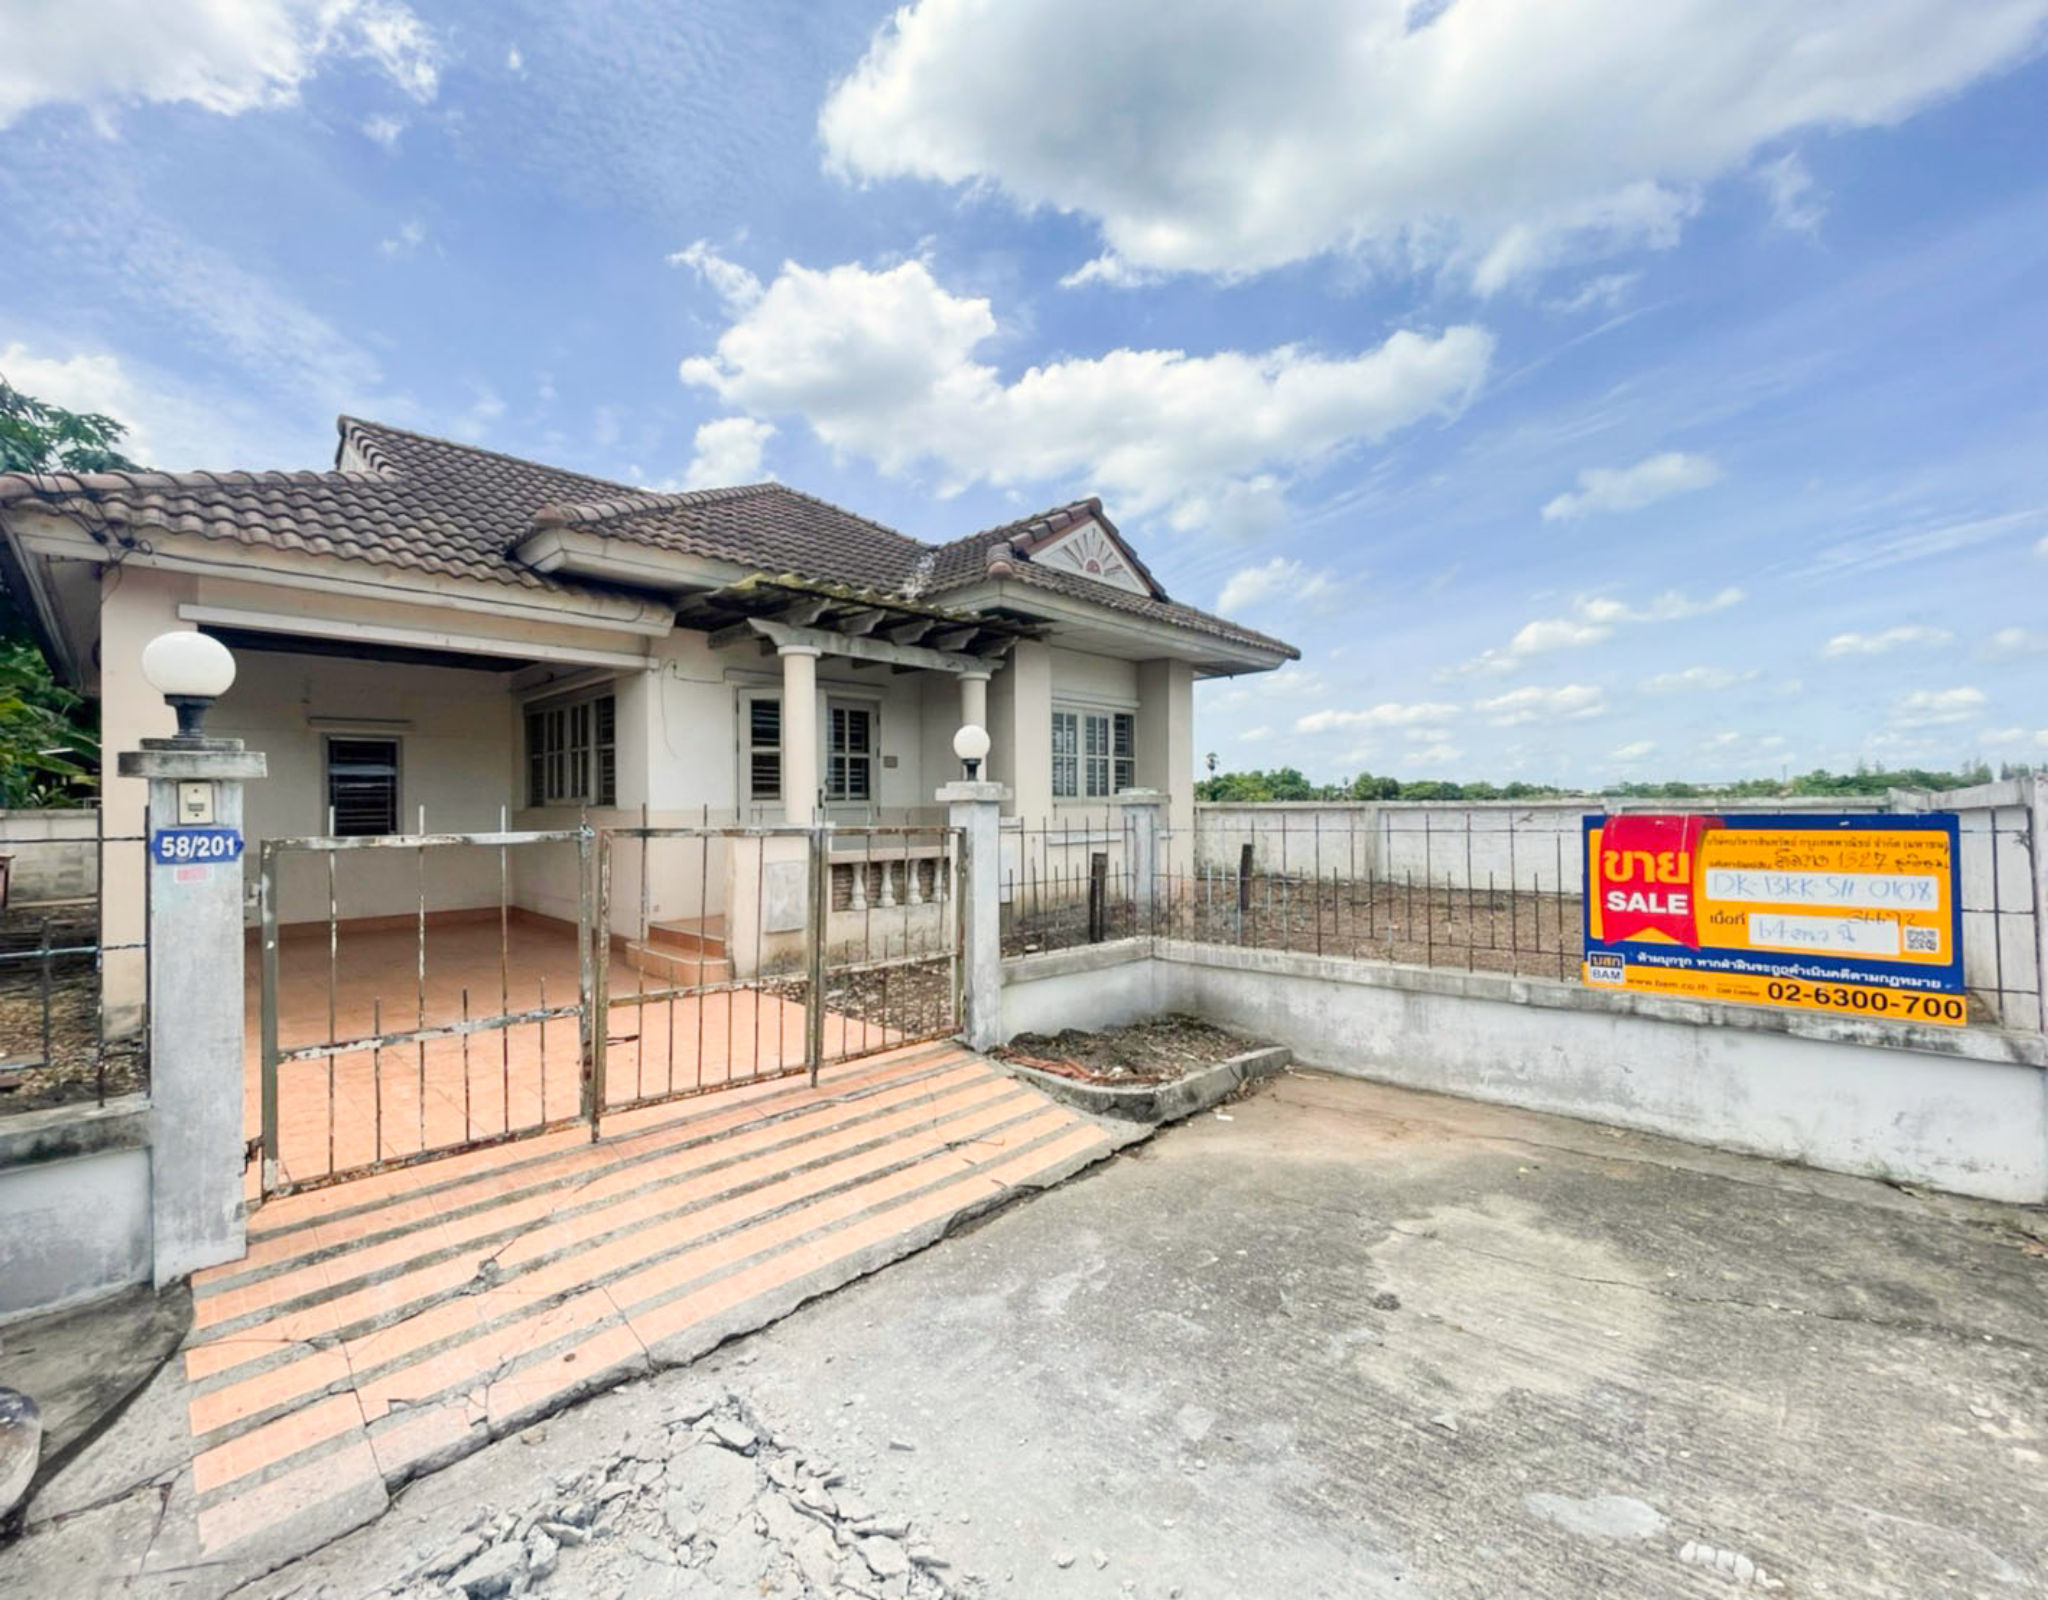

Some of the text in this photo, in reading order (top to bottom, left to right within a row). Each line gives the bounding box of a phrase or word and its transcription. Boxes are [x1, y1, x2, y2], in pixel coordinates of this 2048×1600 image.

[161, 835, 235, 858] 58/201
[1603, 849, 1690, 884] ขาย
[1607, 889, 1689, 915] SALE
[1709, 909, 1746, 925] เนื้อที่
[1637, 951, 1692, 969] ห้ามบุกรุก
[1592, 969, 1621, 981] BAM
[1627, 978, 1708, 991] www.bam.co.th
[1767, 981, 1964, 1020] 02-6300-700
